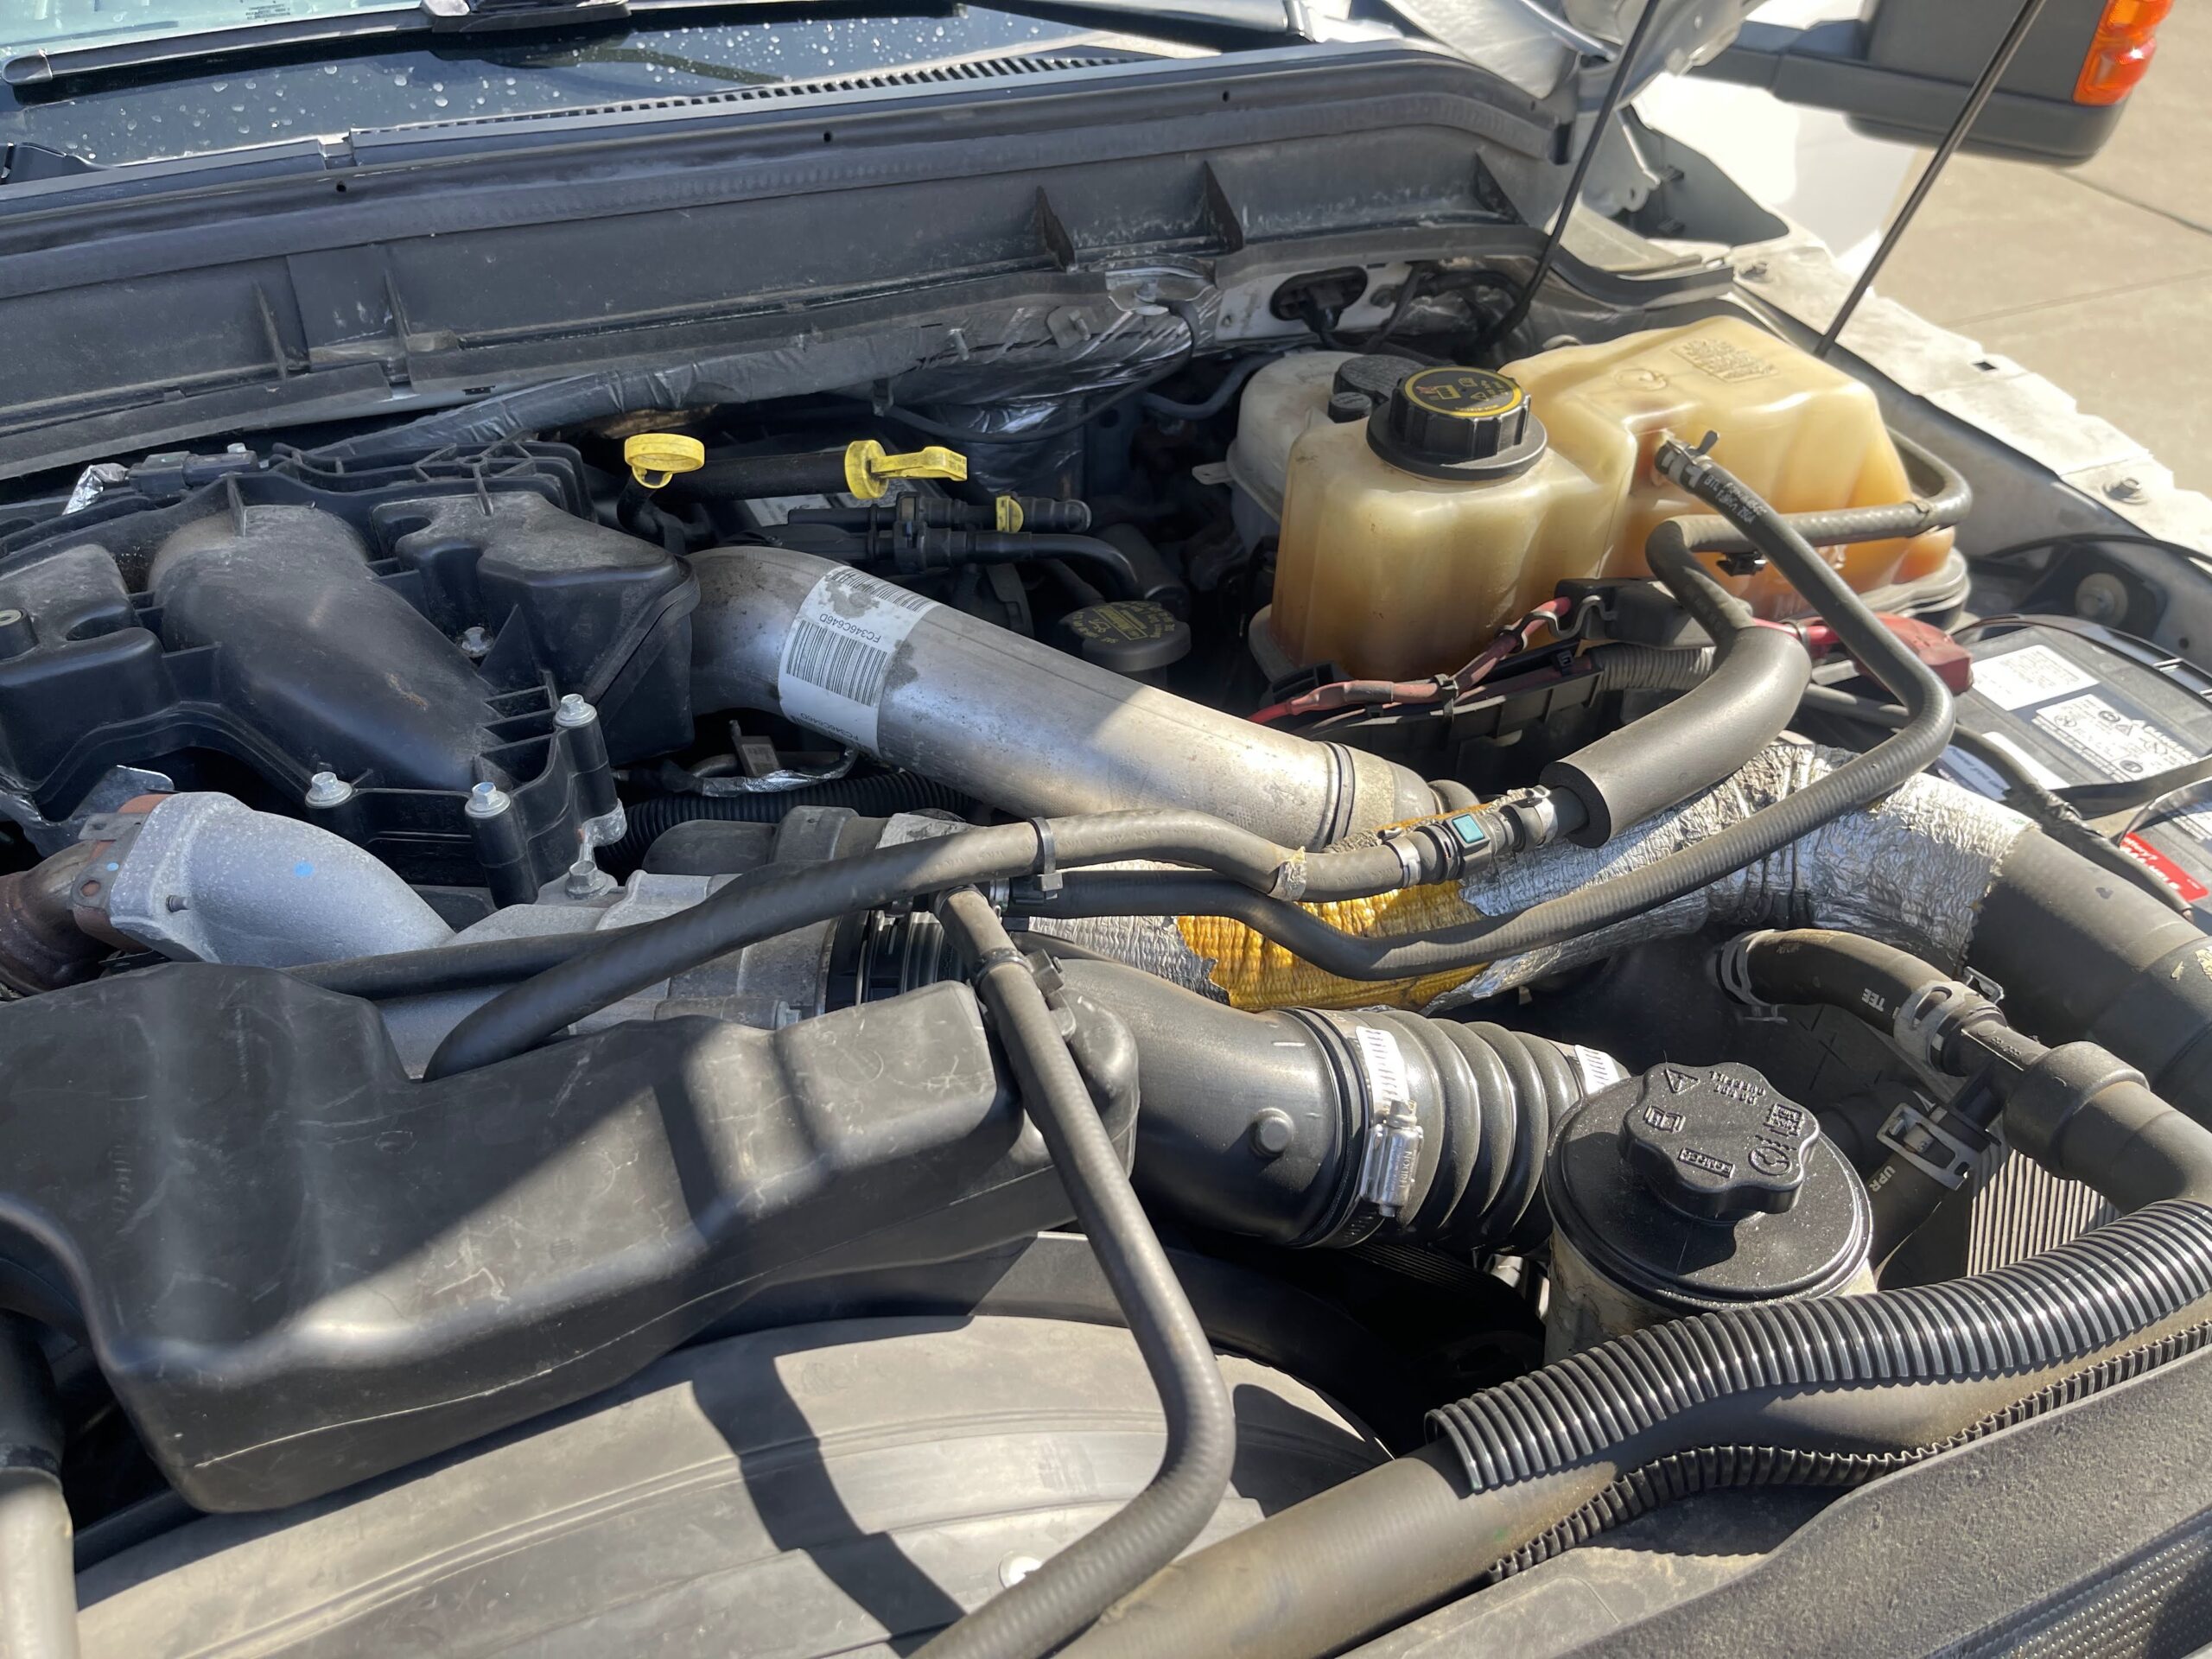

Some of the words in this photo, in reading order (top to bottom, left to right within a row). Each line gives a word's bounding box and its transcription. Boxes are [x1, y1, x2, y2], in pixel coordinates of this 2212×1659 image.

[820, 613, 881, 643] FC346C646D
[1861, 988, 1885, 1012] TEE
[1869, 1165, 1896, 1192] UPR
